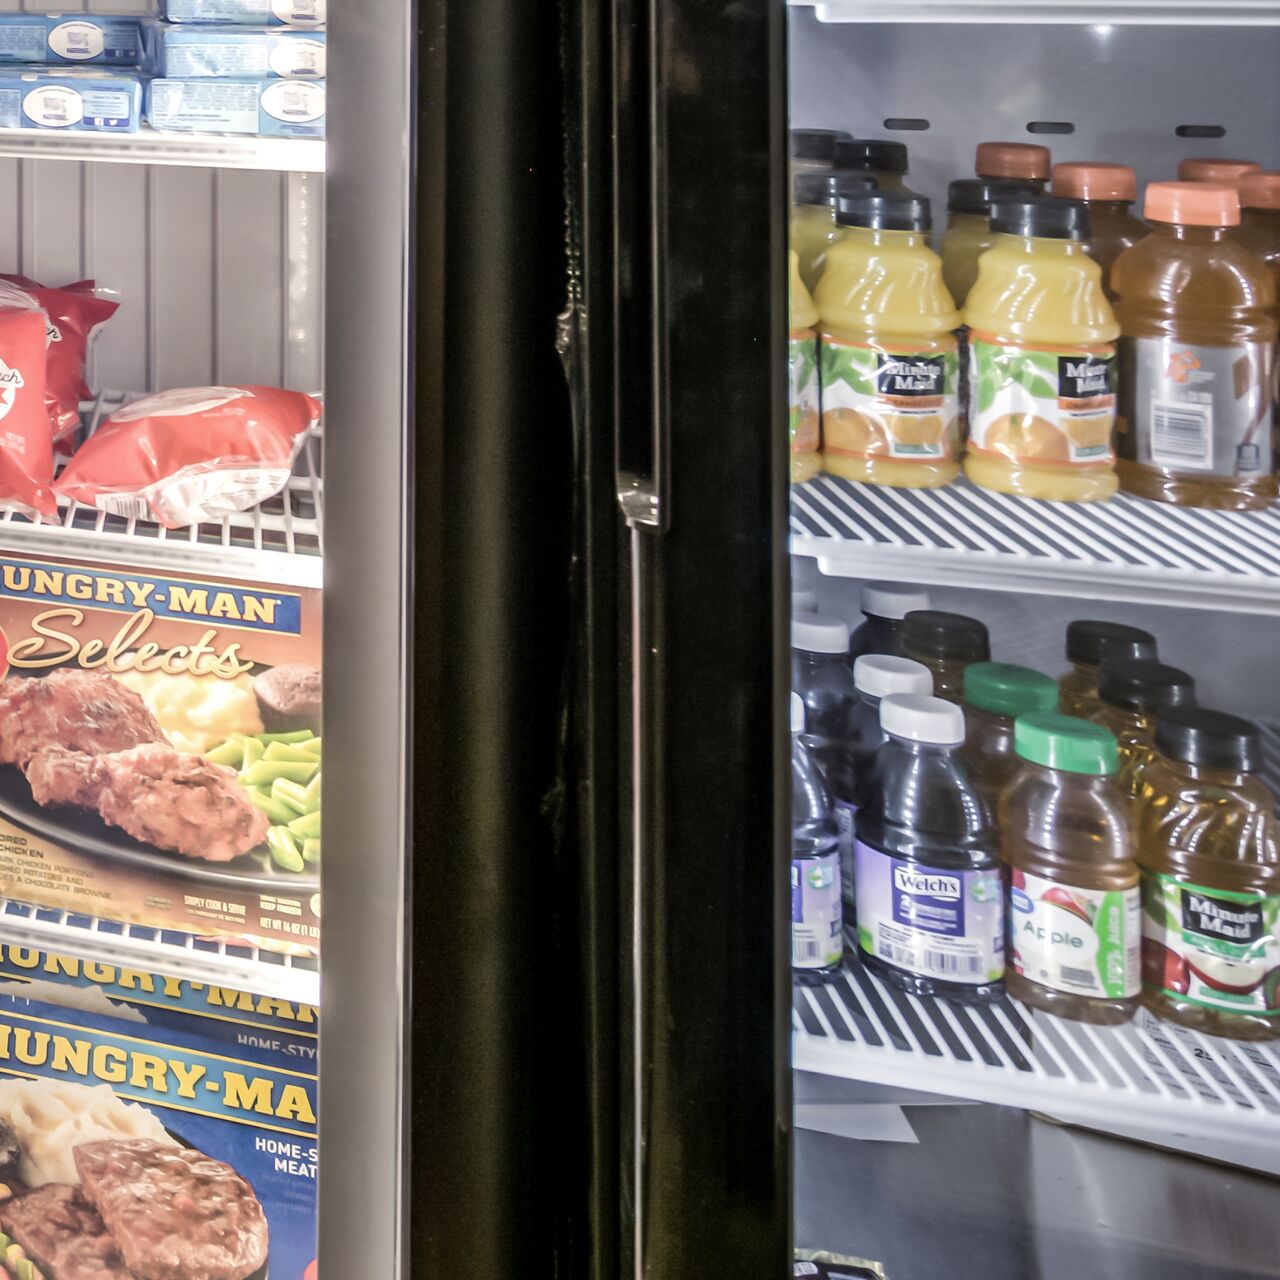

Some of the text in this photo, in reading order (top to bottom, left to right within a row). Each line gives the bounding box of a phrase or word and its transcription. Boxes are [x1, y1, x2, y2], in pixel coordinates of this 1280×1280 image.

[894, 376, 935, 390] Maid
[7, 608, 254, 678] Selects
[17, 859, 51, 871] CHICKEN
[900, 874, 957, 893] Welch's
[1023, 920, 1084, 949] Apple
[1200, 915, 1251, 939] Maid
[256, 1137, 317, 1162] HOME-S
[275, 1158, 317, 1178] MEAT
